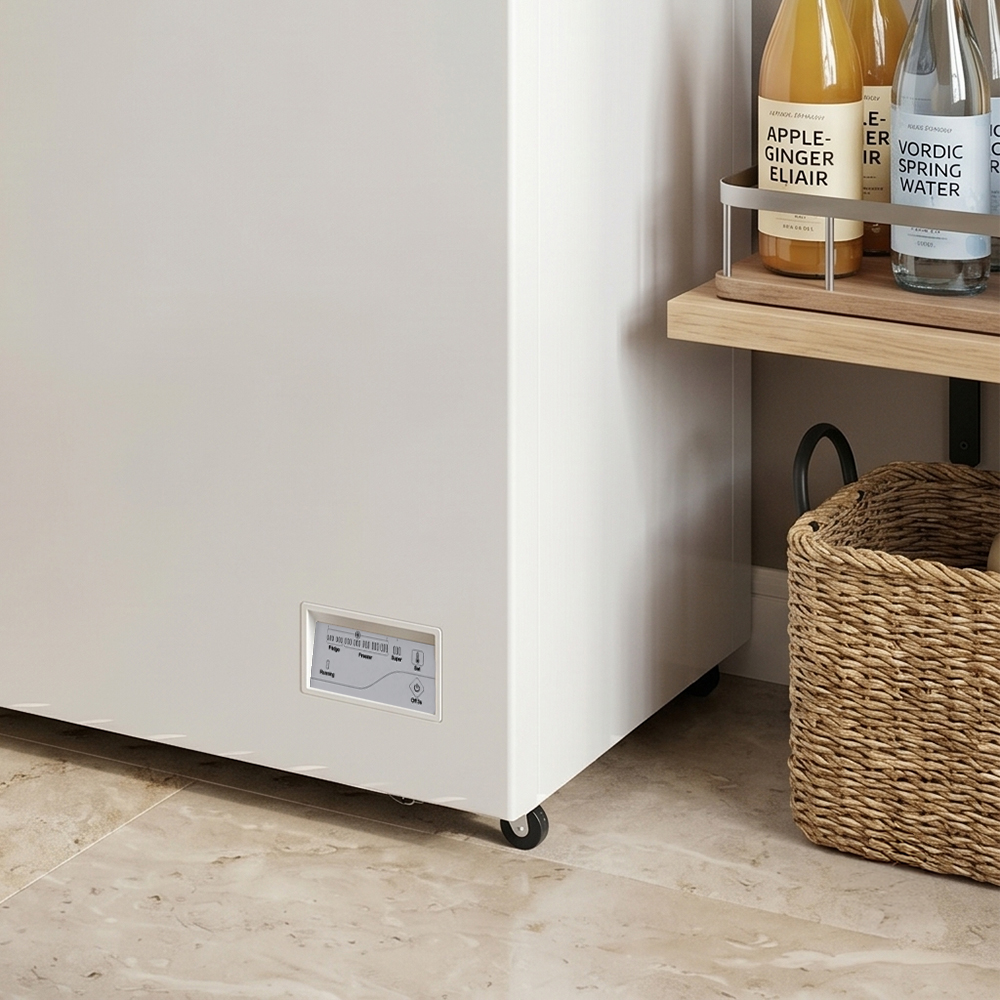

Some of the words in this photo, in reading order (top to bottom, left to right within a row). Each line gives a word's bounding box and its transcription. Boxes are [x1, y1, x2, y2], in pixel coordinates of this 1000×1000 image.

[863, 111, 887, 127] E-
[766, 126, 832, 146] APPLE-
[765, 146, 834, 166] GINGER
[898, 139, 963, 160] VORDIC
[770, 166, 828, 186] ELIAIR
[898, 158, 961, 178] SPRING
[900, 176, 960, 197] WATER
